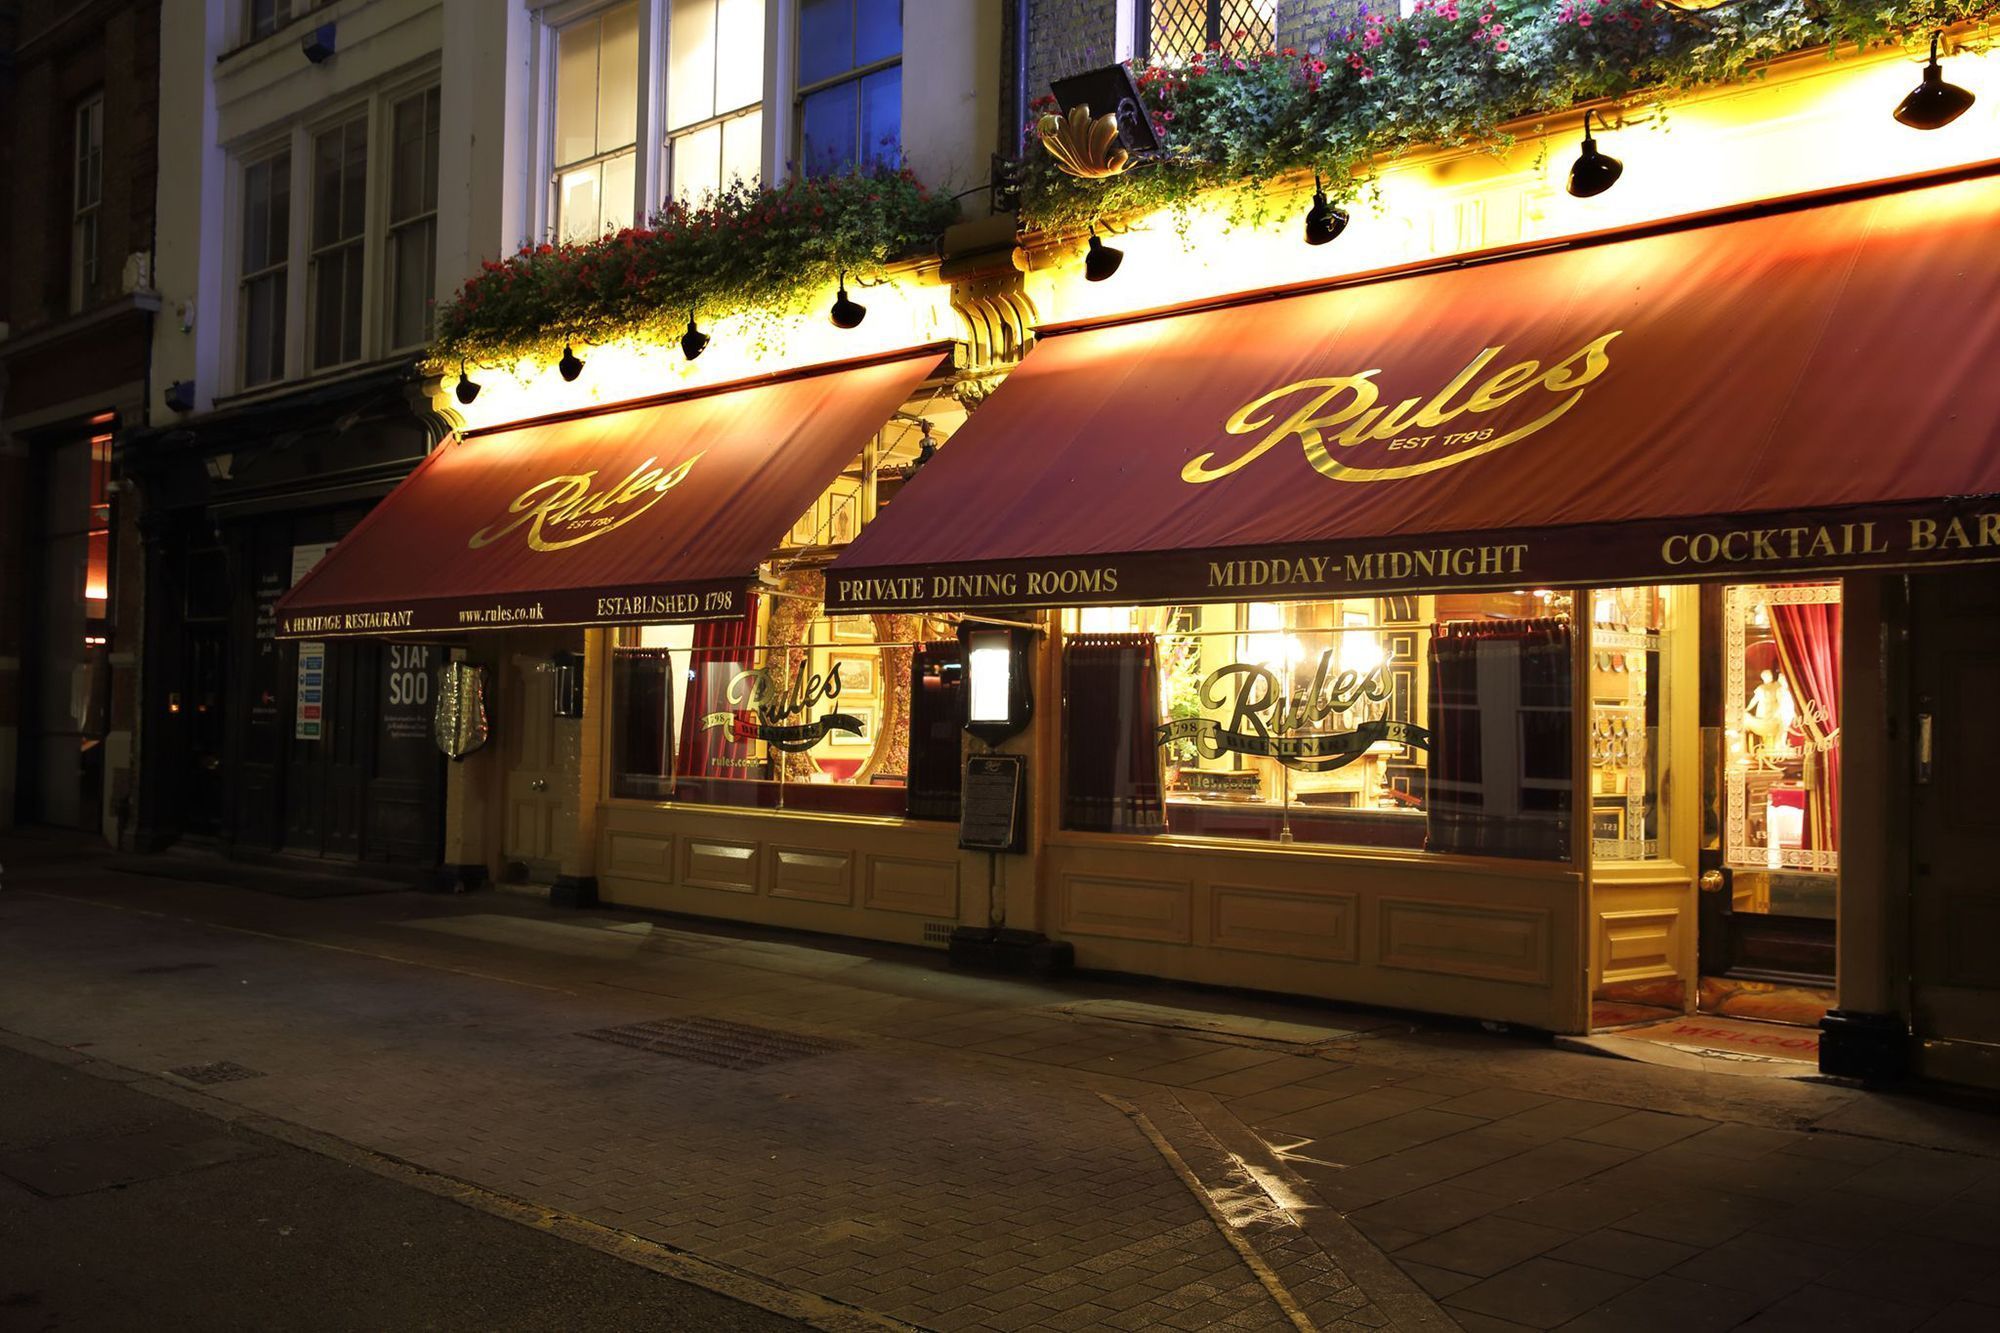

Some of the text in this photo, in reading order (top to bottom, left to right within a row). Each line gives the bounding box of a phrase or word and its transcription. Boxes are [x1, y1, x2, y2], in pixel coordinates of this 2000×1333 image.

[1181, 329, 1623, 484] Rules
[1387, 427, 1495, 452] EST 1798
[468, 448, 708, 552] Rules
[566, 519, 591, 530] EST
[1661, 512, 2000, 566] COCKTAIL BAR
[1207, 543, 1529, 588] MIDDAY-MIDNIGHT
[838, 567, 1119, 602] PRIVATE DINING ROOMS
[458, 602, 545, 623] www.rules.co.uk
[596, 590, 733, 617] ESTABLISHED 1798
[283, 609, 414, 633] A HERITAGE RESTAURANT
[724, 659, 842, 740] Rules
[1198, 649, 1394, 755] Rules
[1166, 721, 1198, 738] 1798
[1226, 735, 1350, 756] BICENTENARY
